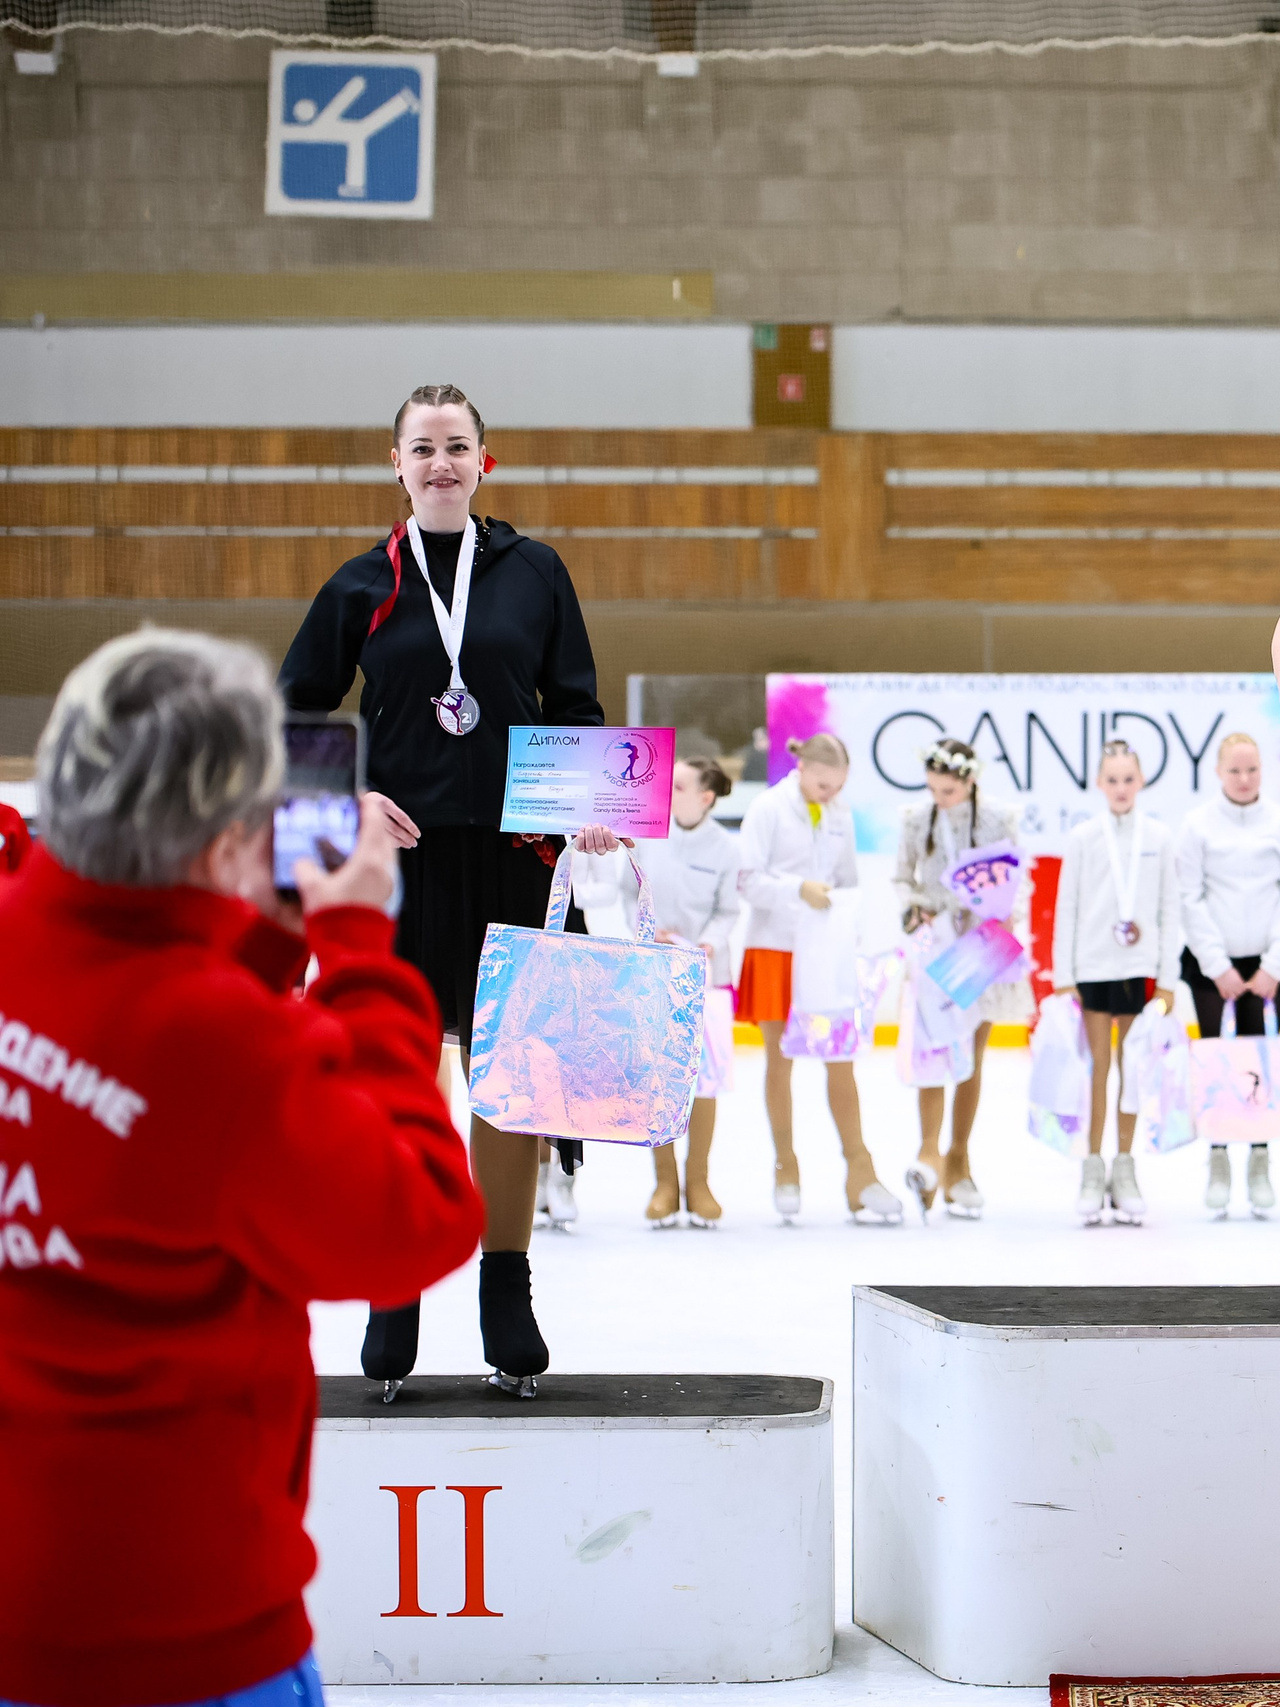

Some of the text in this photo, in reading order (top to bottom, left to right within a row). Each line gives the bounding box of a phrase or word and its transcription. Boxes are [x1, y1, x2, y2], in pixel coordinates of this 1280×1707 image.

[602, 769, 657, 788] КУБОК CANDY
[872, 711, 1226, 792] CANDY
[379, 1485, 504, 1617] II
